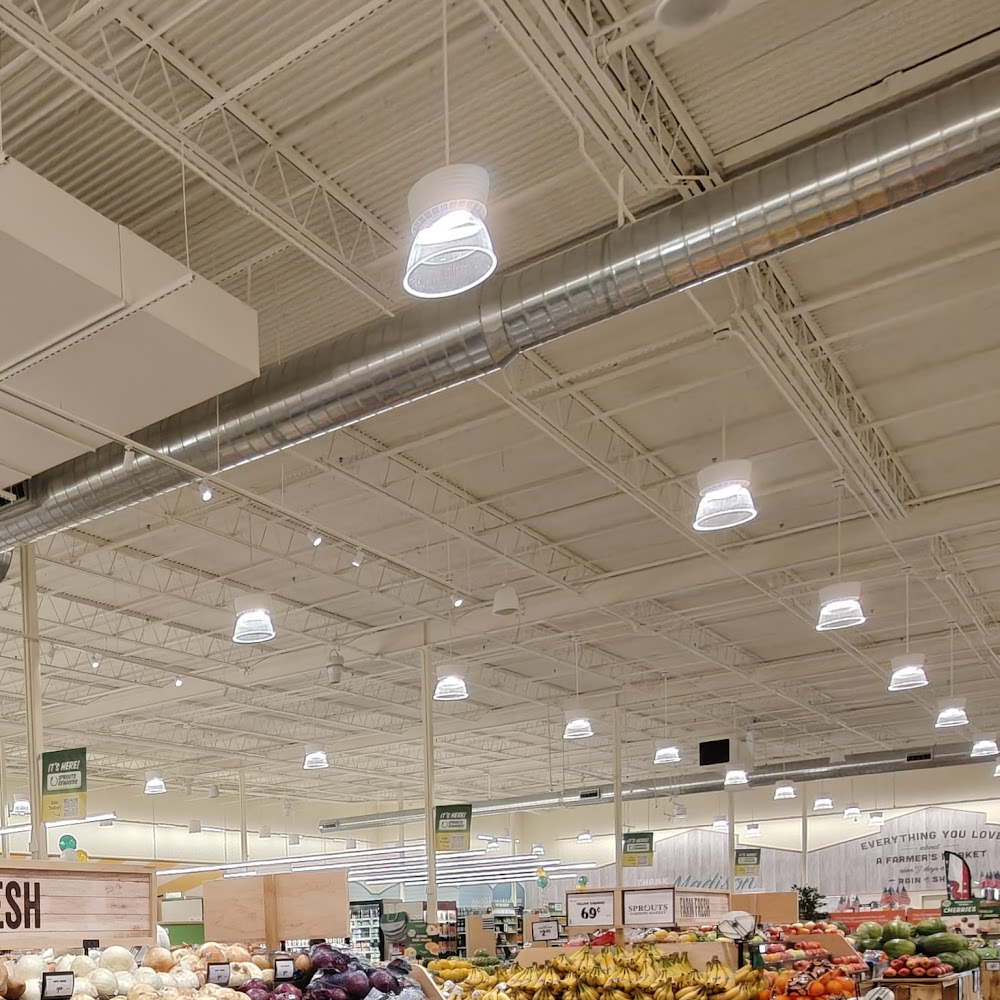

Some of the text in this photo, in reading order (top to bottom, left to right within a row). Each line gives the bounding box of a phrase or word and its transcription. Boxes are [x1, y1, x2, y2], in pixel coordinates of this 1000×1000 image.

[47, 759, 81, 773] IT'S HERE!
[860, 831, 937, 851] EVERYTHING
[942, 830, 966, 839] YOU
[876, 853, 938, 865] A FARMER'S
[628, 904, 669, 912] SPROUTS
